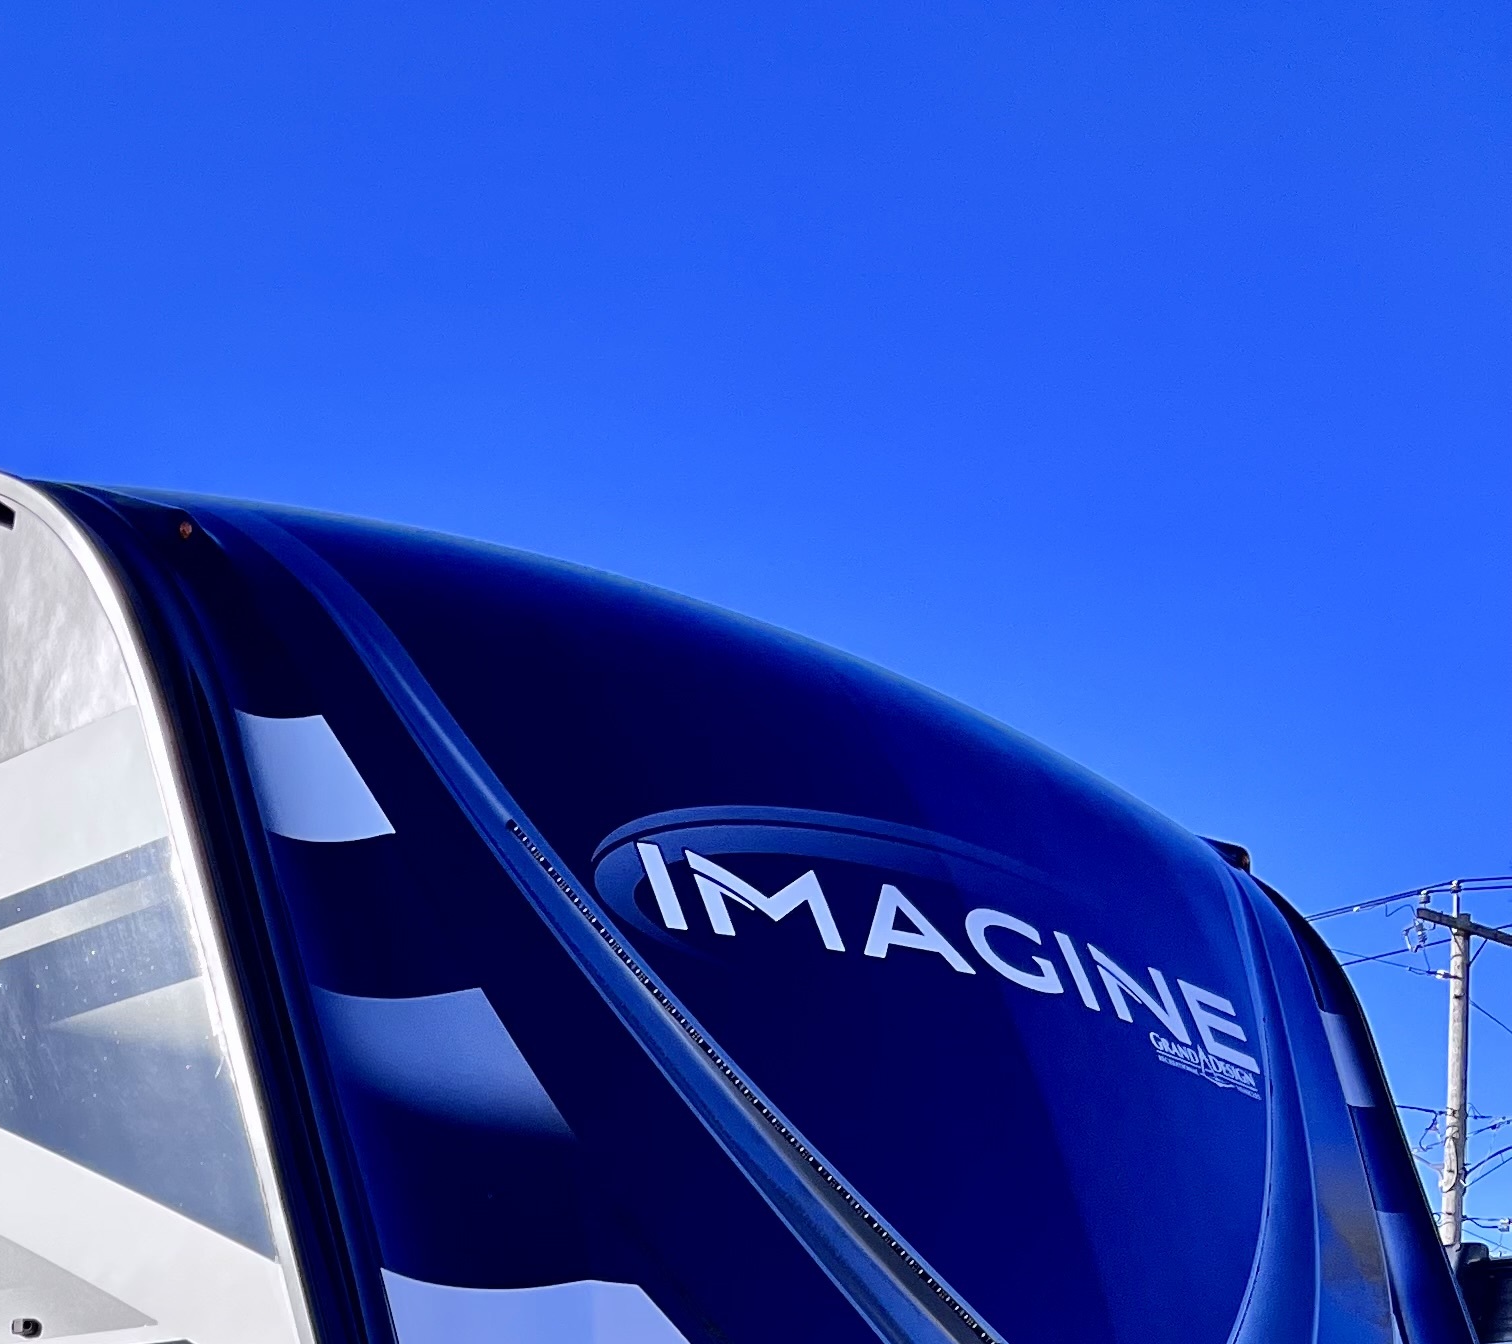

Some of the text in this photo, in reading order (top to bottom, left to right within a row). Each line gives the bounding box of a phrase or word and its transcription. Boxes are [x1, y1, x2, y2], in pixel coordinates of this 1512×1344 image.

[636, 841, 1261, 1074] IMAGINE
[1149, 1031, 1199, 1064] GRAND
[1207, 1054, 1256, 1087] DESIGN
